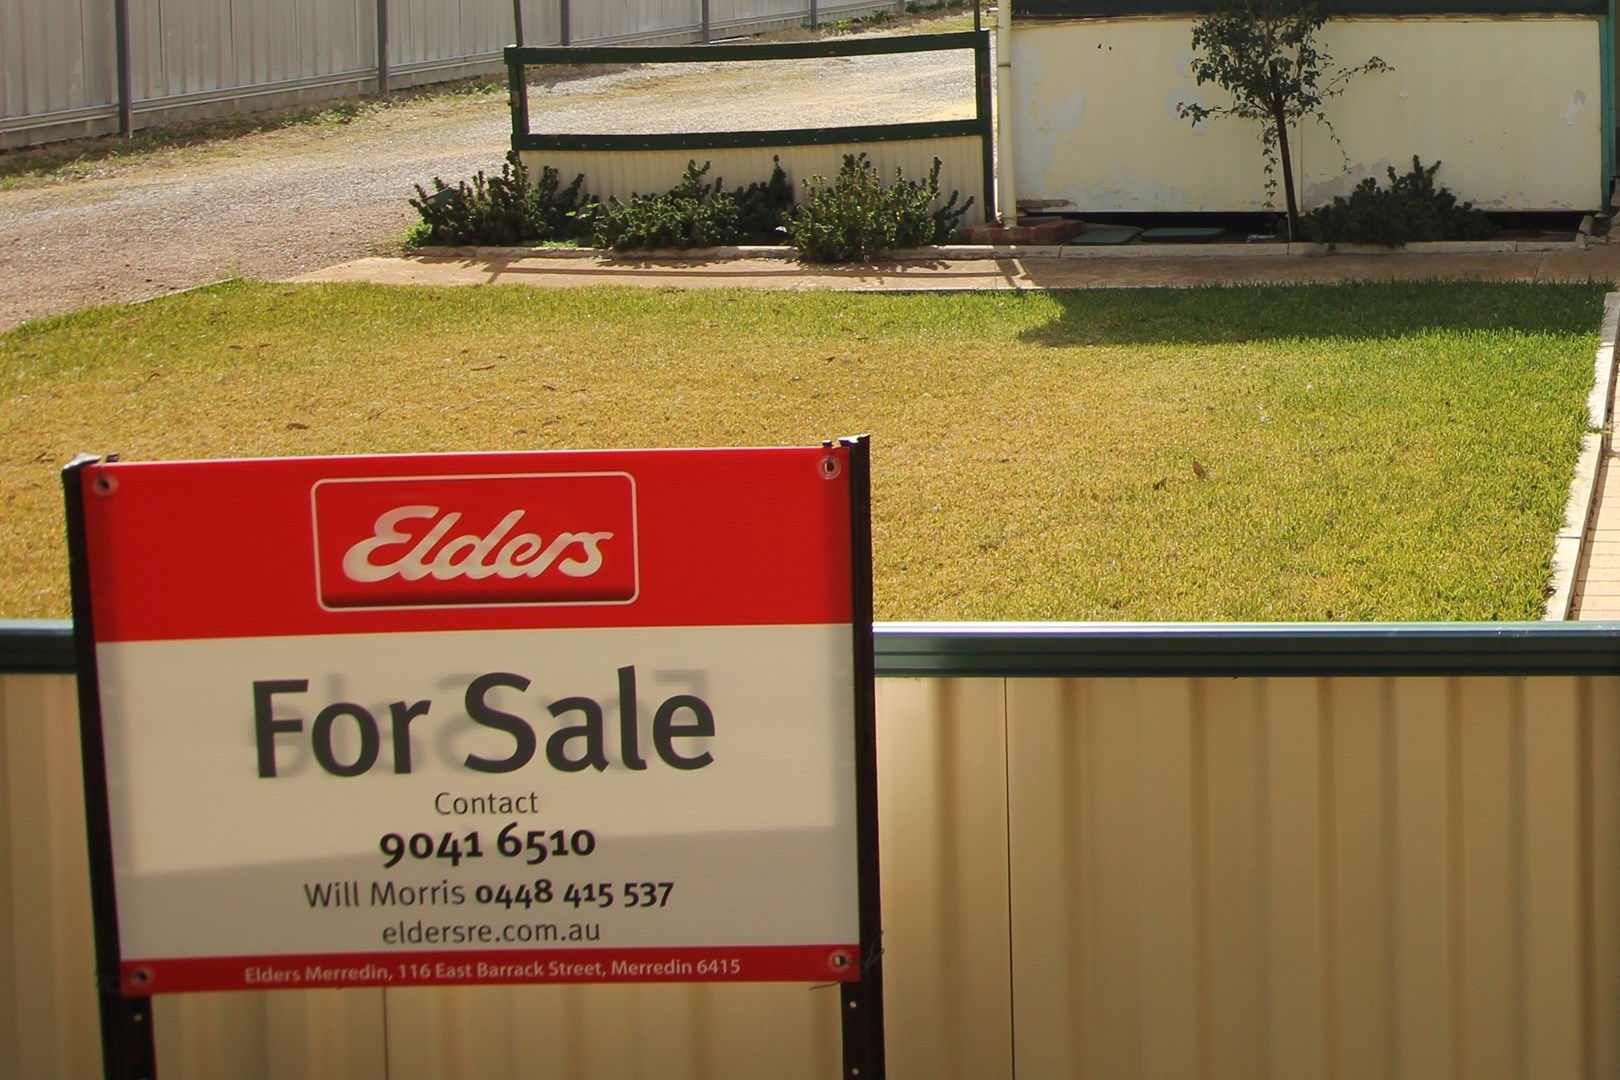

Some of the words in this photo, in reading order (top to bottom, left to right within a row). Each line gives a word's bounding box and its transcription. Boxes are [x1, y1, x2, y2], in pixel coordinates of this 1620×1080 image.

[343, 505, 614, 582] Elders
[253, 679, 431, 778] For
[463, 665, 715, 774] Sale
[435, 792, 539, 815] Contact
[380, 831, 483, 869] 9041
[497, 821, 596, 865] 6510
[304, 881, 360, 908] Will
[371, 879, 466, 907] Morris
[475, 879, 553, 909] 0448
[563, 882, 614, 908] 415
[623, 882, 674, 908] 537
[382, 921, 600, 944] eldersre.com.au
[245, 967, 300, 983] Elders
[305, 965, 393, 981] Merredin,
[399, 964, 431, 979] 116
[436, 963, 472, 978] East
[477, 961, 543, 977] Barrack
[549, 960, 606, 977] Street,
[611, 960, 692, 976] Merredin
[697, 958, 741, 974] 6415
